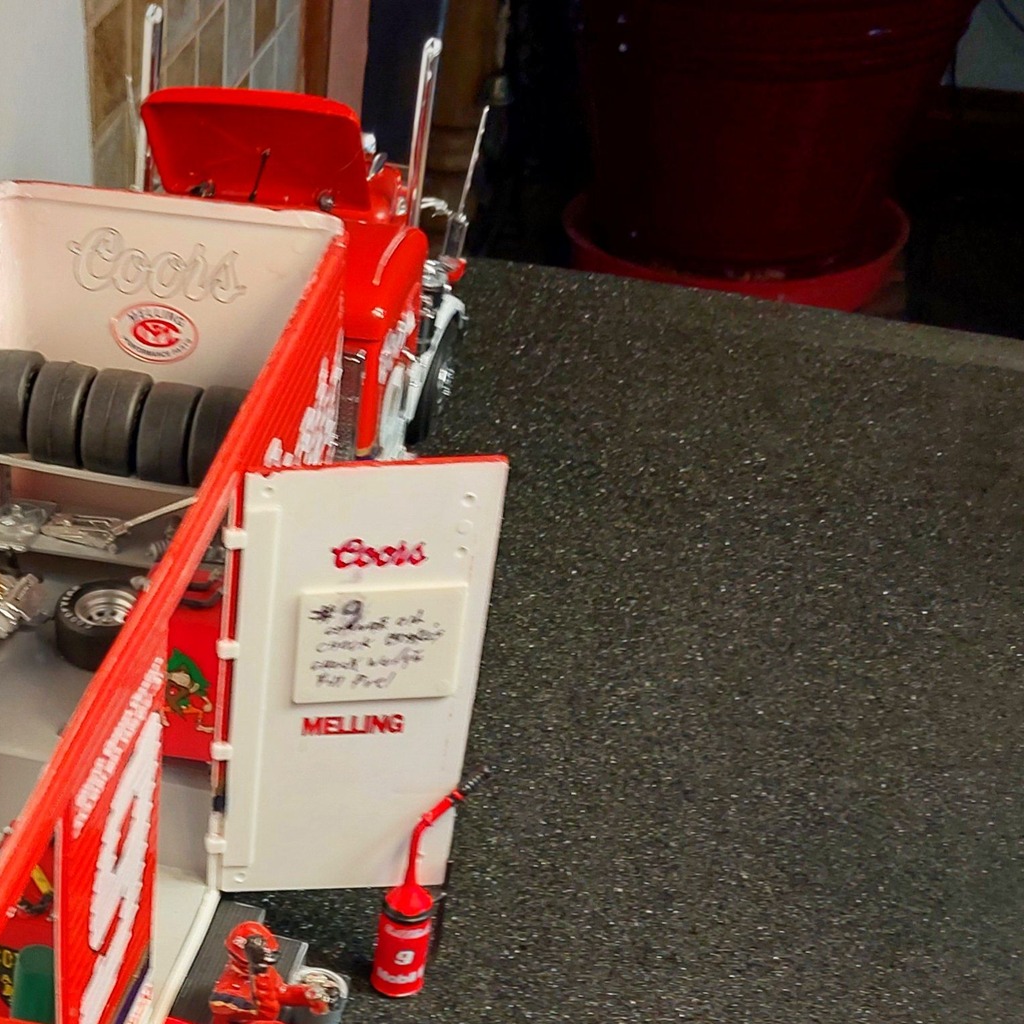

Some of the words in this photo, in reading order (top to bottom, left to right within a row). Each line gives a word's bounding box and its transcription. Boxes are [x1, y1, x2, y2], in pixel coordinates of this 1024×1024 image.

[67, 227, 247, 303] Coors
[301, 712, 406, 737] MELLING
[394, 950, 416, 966] 9
